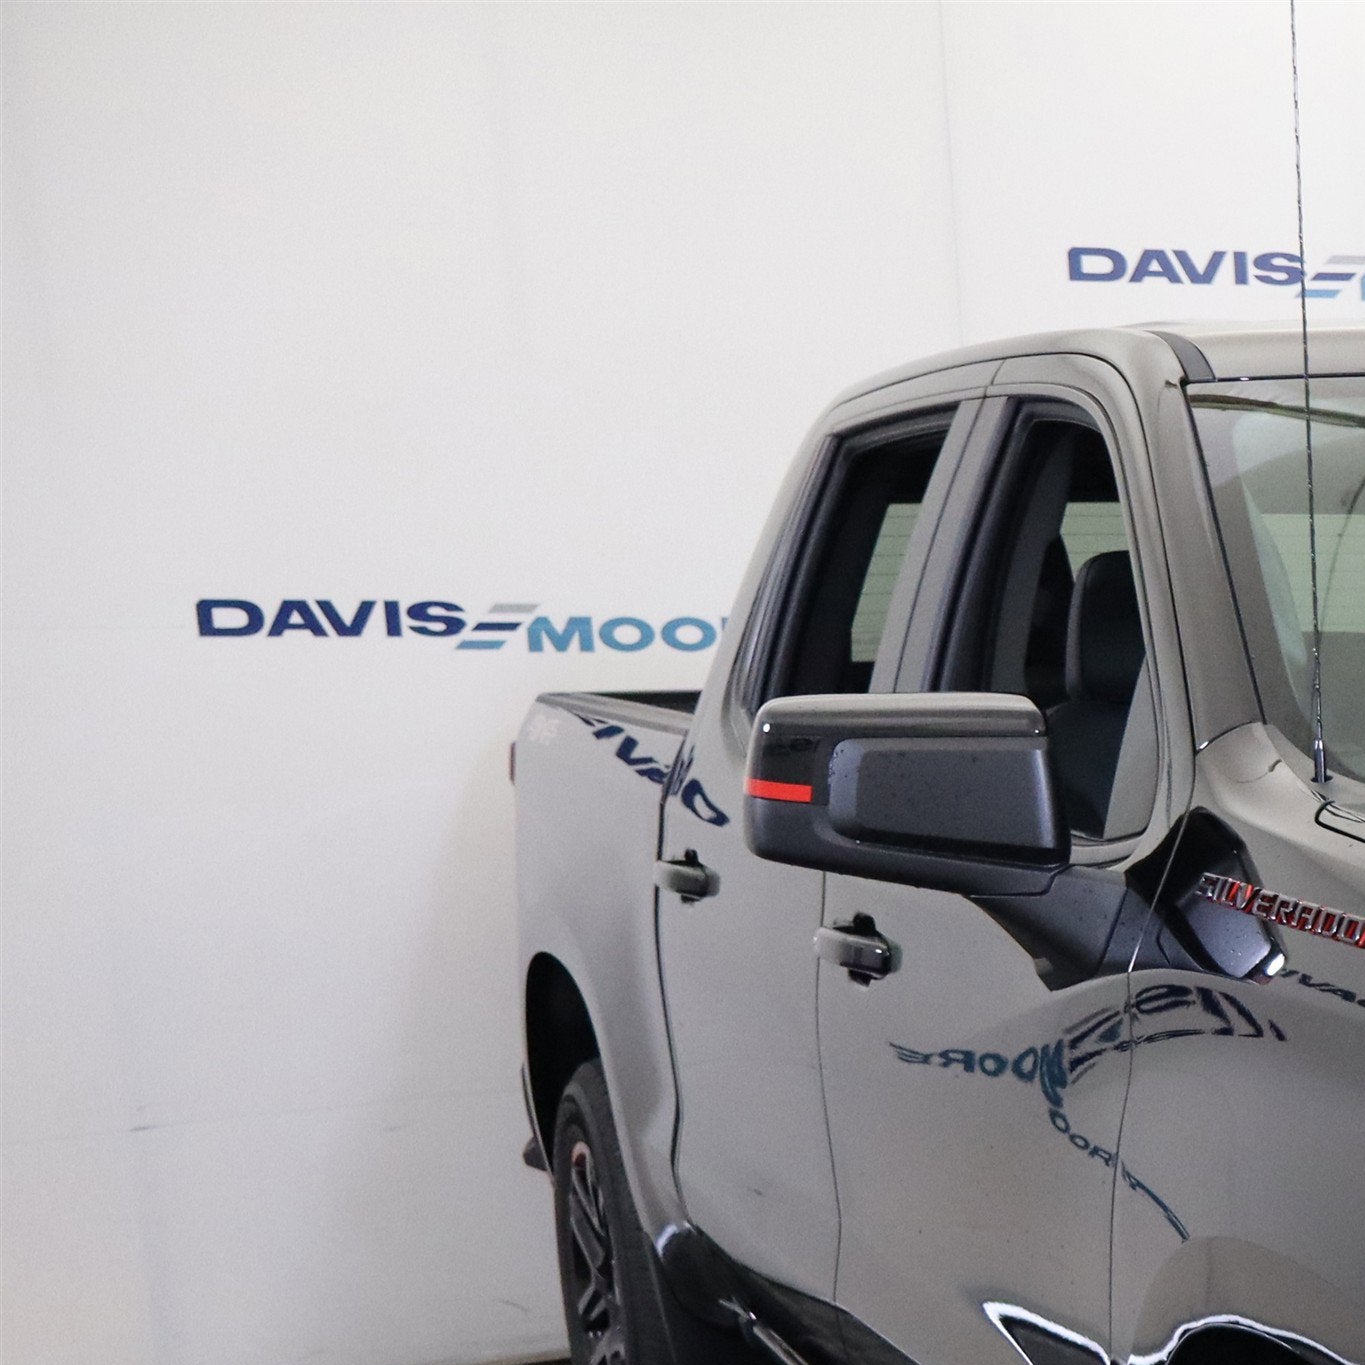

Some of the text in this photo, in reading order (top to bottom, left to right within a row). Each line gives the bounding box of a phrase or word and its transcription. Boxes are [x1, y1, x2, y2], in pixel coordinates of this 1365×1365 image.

[1067, 246, 1304, 286] DAVIS
[196, 598, 729, 653] DAVIS MOO
